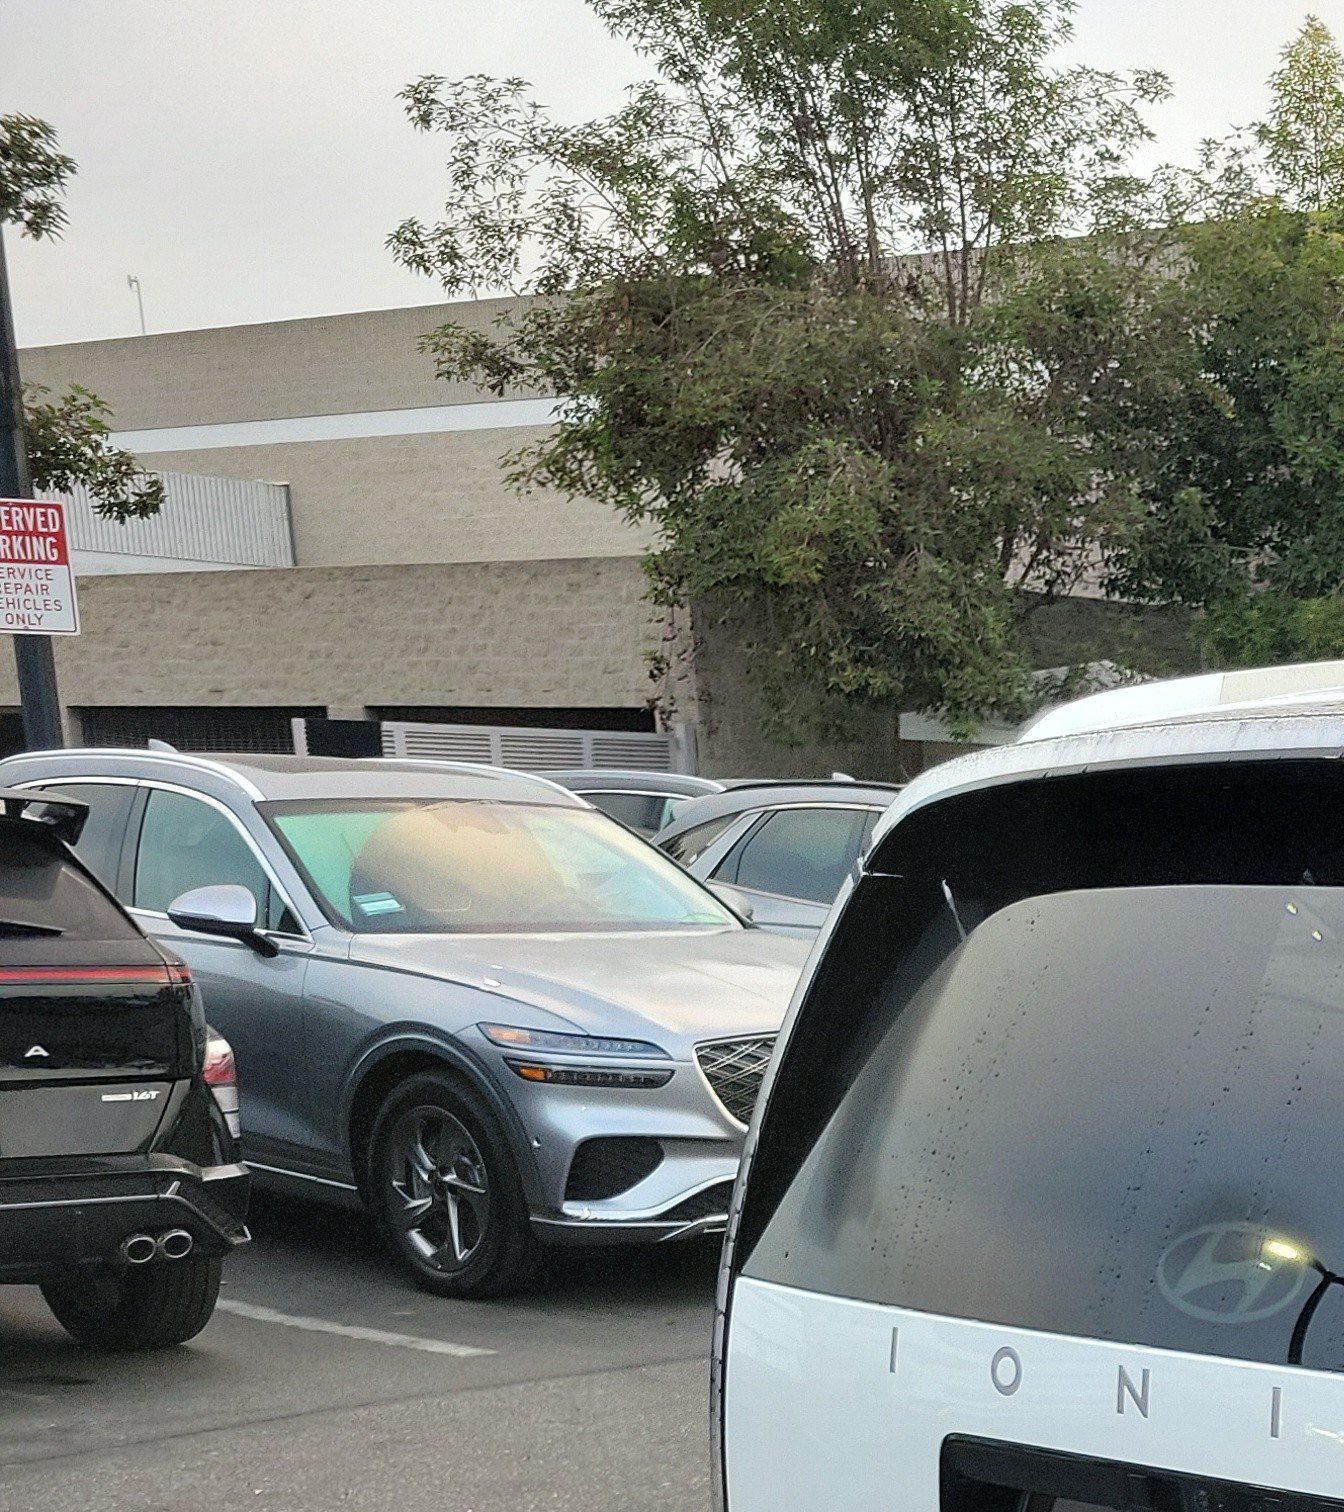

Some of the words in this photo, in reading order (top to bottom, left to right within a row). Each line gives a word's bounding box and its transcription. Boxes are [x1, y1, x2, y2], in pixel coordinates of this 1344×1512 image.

[0, 506, 60, 533] ERVED
[0, 582, 50, 596] EPAIR
[5, 612, 43, 626] ONLY
